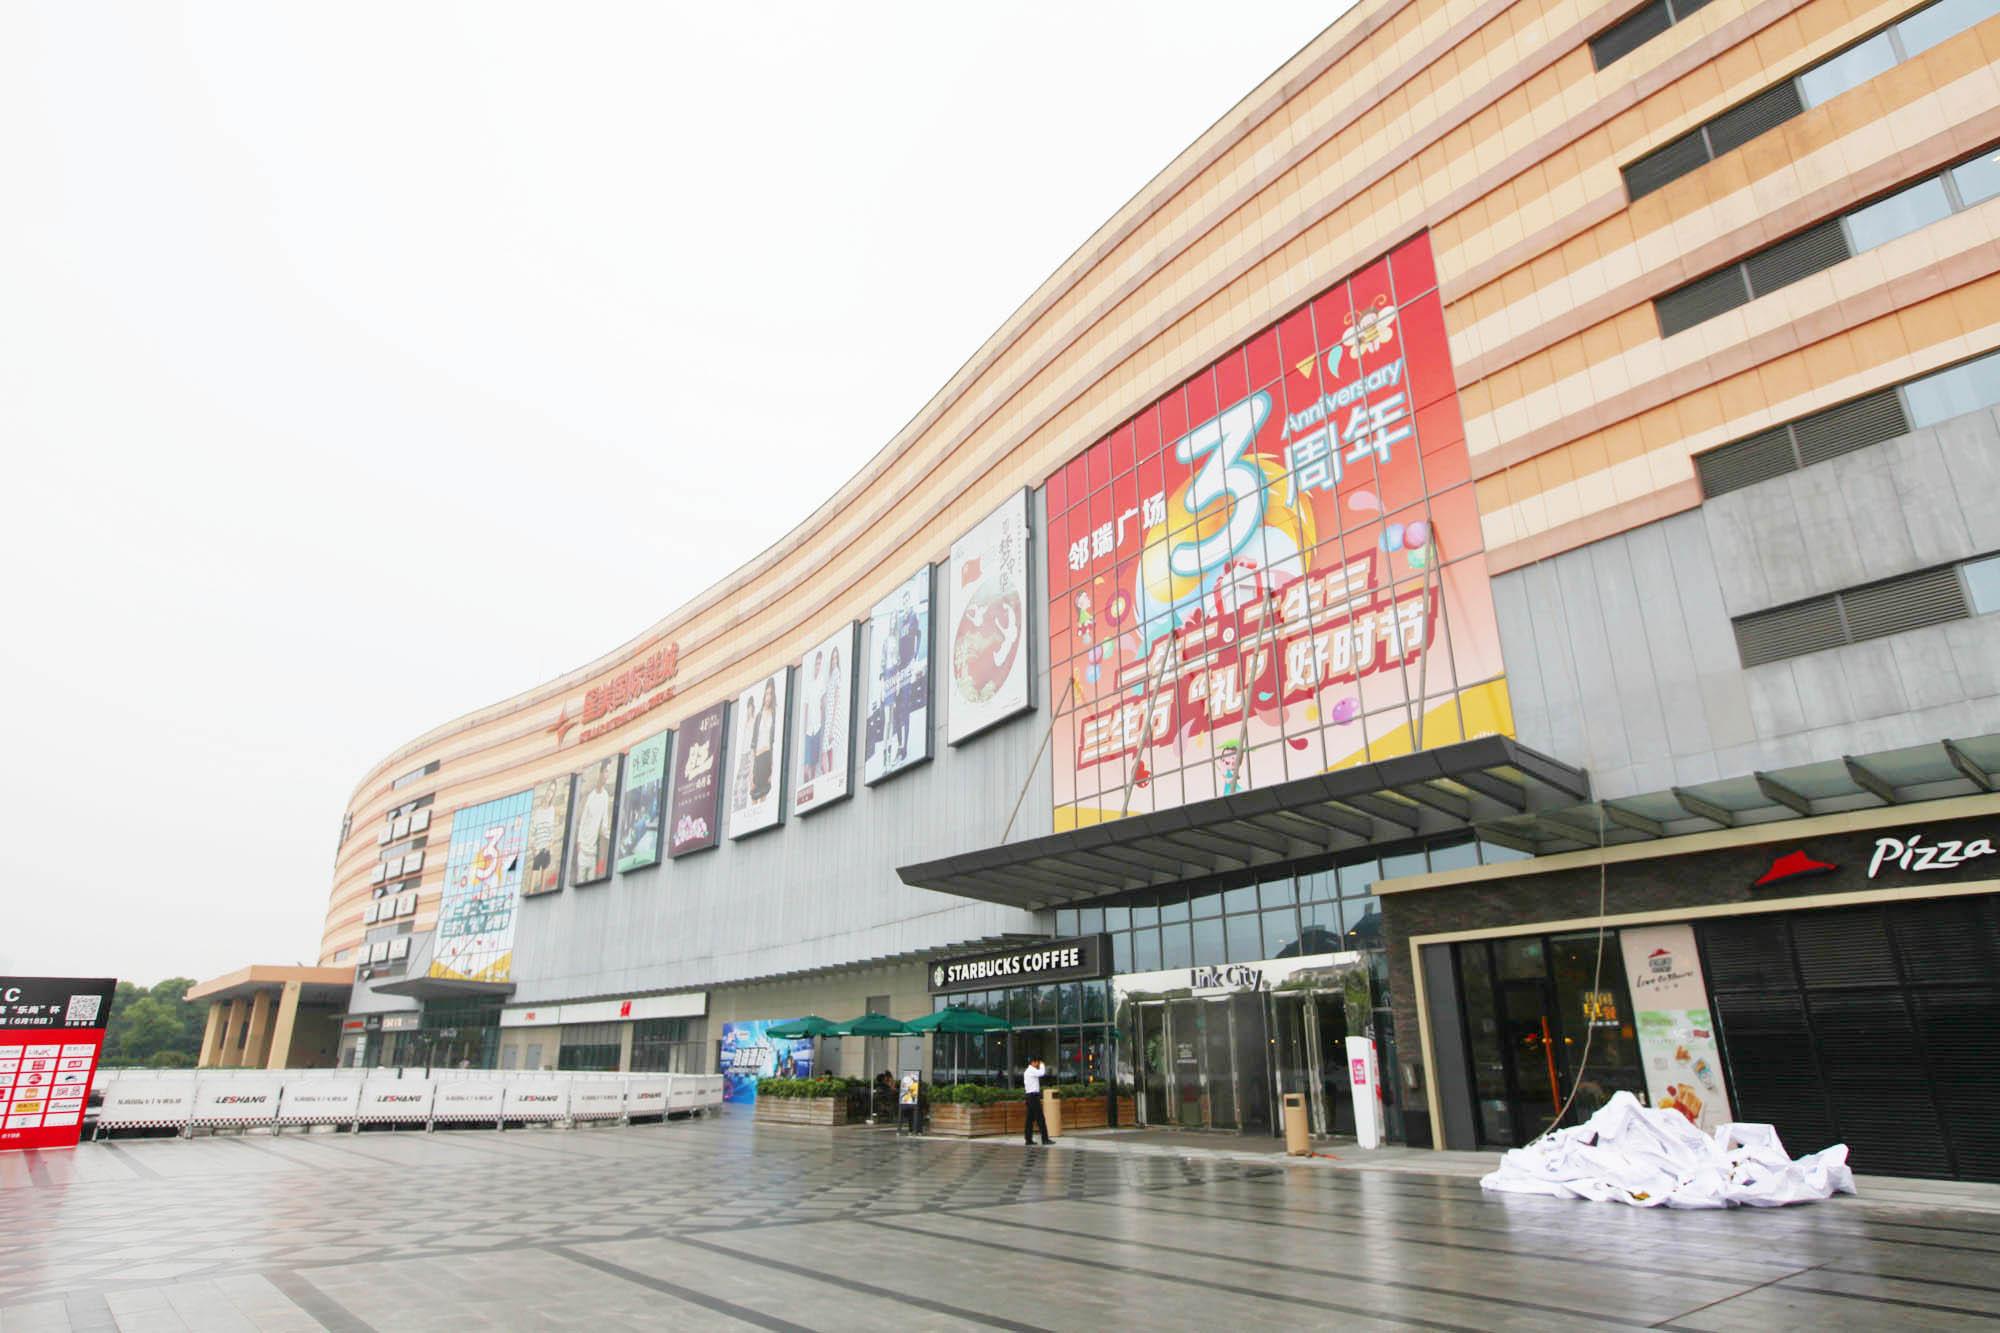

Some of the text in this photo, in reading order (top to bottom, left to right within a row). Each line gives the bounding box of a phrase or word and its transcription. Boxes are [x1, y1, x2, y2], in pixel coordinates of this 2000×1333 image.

[1281, 358, 1404, 440] Anniversary
[1284, 392, 1412, 508] 周年
[1172, 390, 1272, 577] 3
[1067, 490, 1167, 573] 邻瑞广场
[1867, 833, 1997, 879] Pizza
[947, 947, 1079, 983] STARBUCKS COFFEE
[1226, 965, 1262, 992] City
[215, 1095, 267, 1104] LESHANG
[376, 1095, 422, 1103] LESHANG
